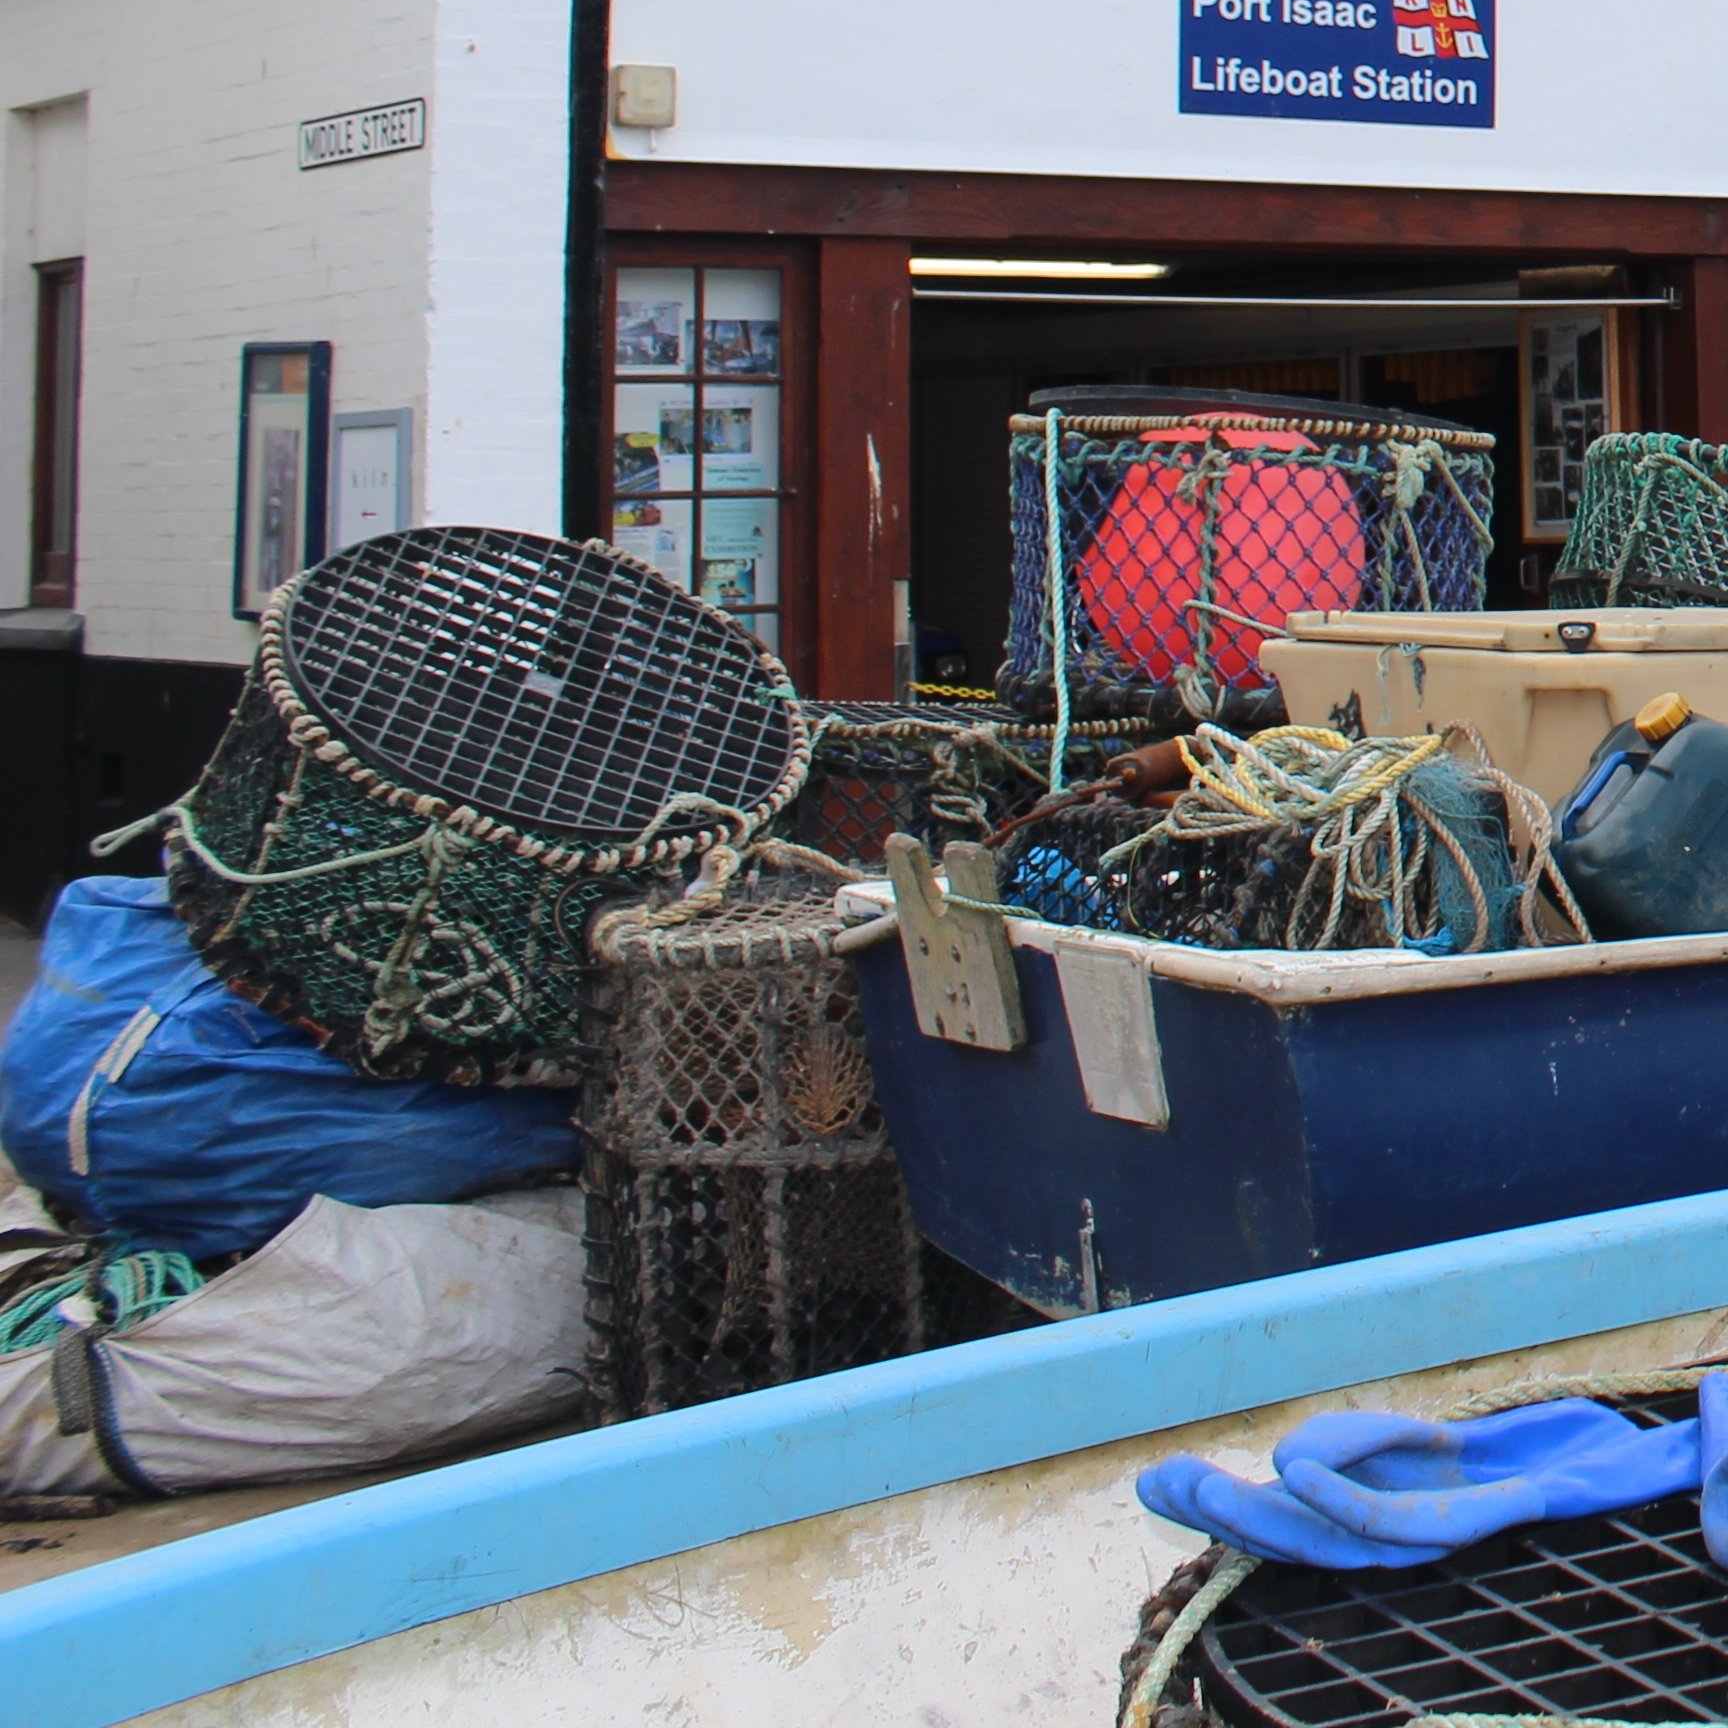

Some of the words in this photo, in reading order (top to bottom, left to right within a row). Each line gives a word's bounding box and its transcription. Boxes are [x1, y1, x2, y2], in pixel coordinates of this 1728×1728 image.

[1191, 56, 1342, 99] Lifeboat
[1352, 64, 1477, 105] Station
[304, 120, 353, 163] MIDDLE
[361, 106, 417, 151] STREET
